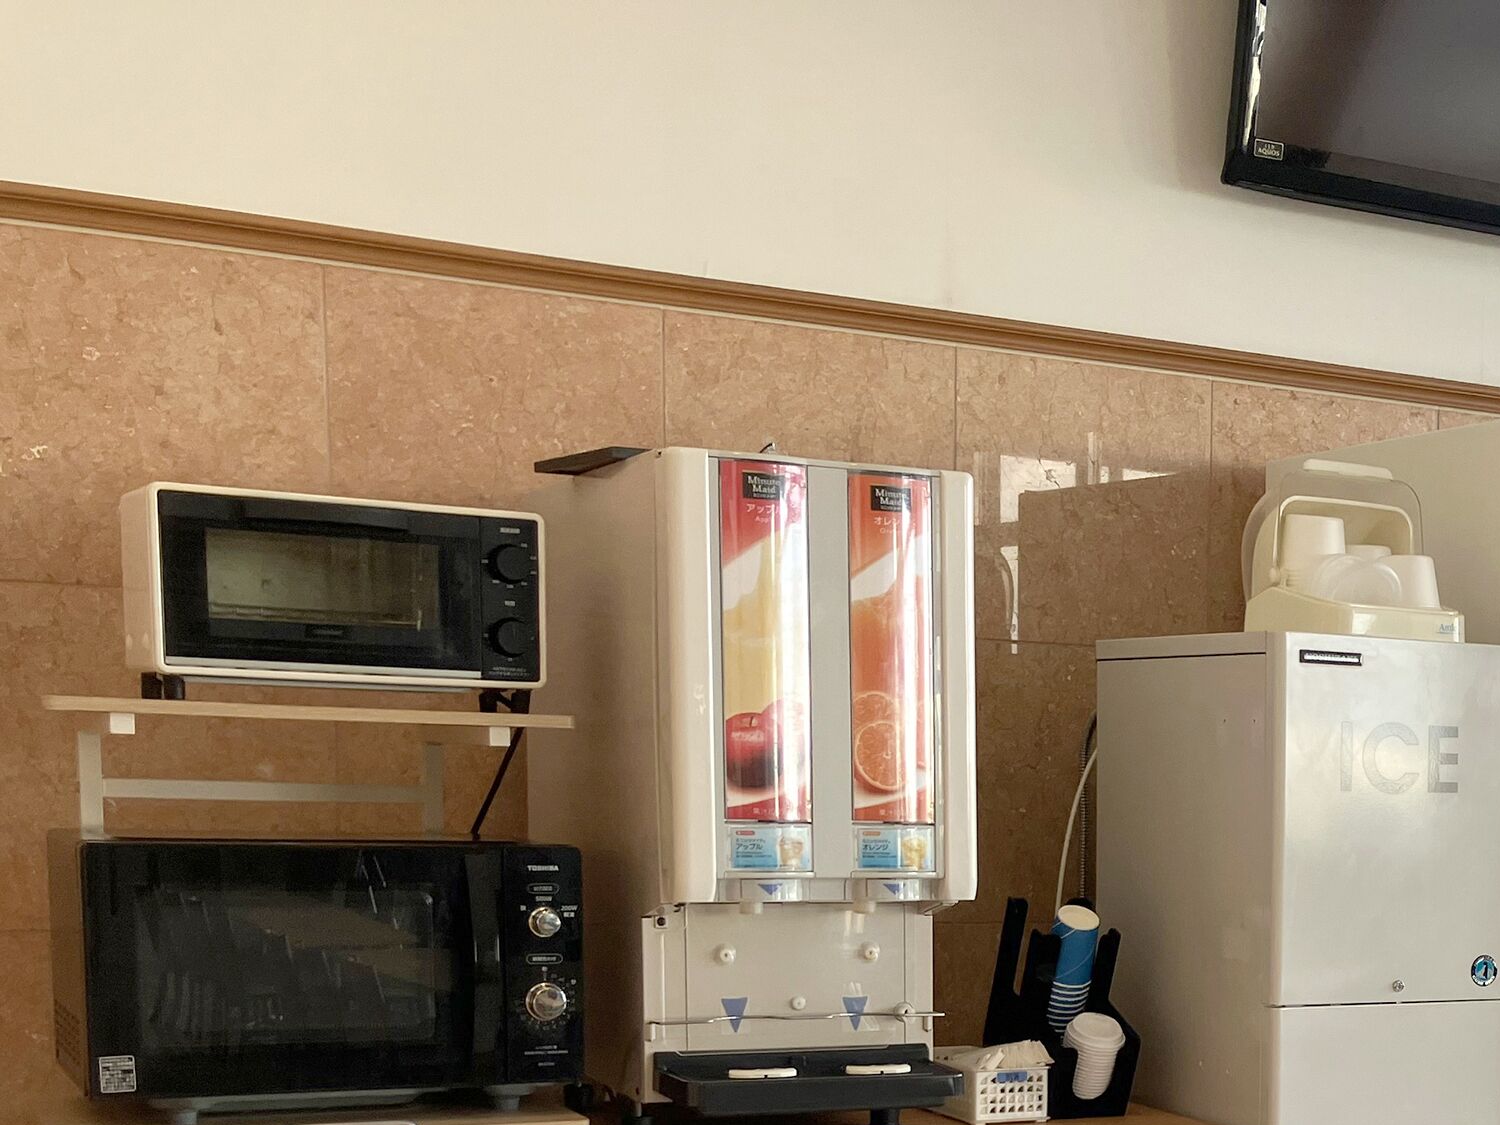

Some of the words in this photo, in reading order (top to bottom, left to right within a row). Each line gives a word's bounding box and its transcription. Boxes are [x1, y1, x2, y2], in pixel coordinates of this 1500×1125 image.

[747, 475, 781, 487] Minute
[752, 484, 776, 494] Maid
[1339, 719, 1460, 796] ICE
[735, 843, 764, 851] アップル
[862, 843, 889, 851] オレンジ
[527, 864, 560, 872] TOSHIBA
